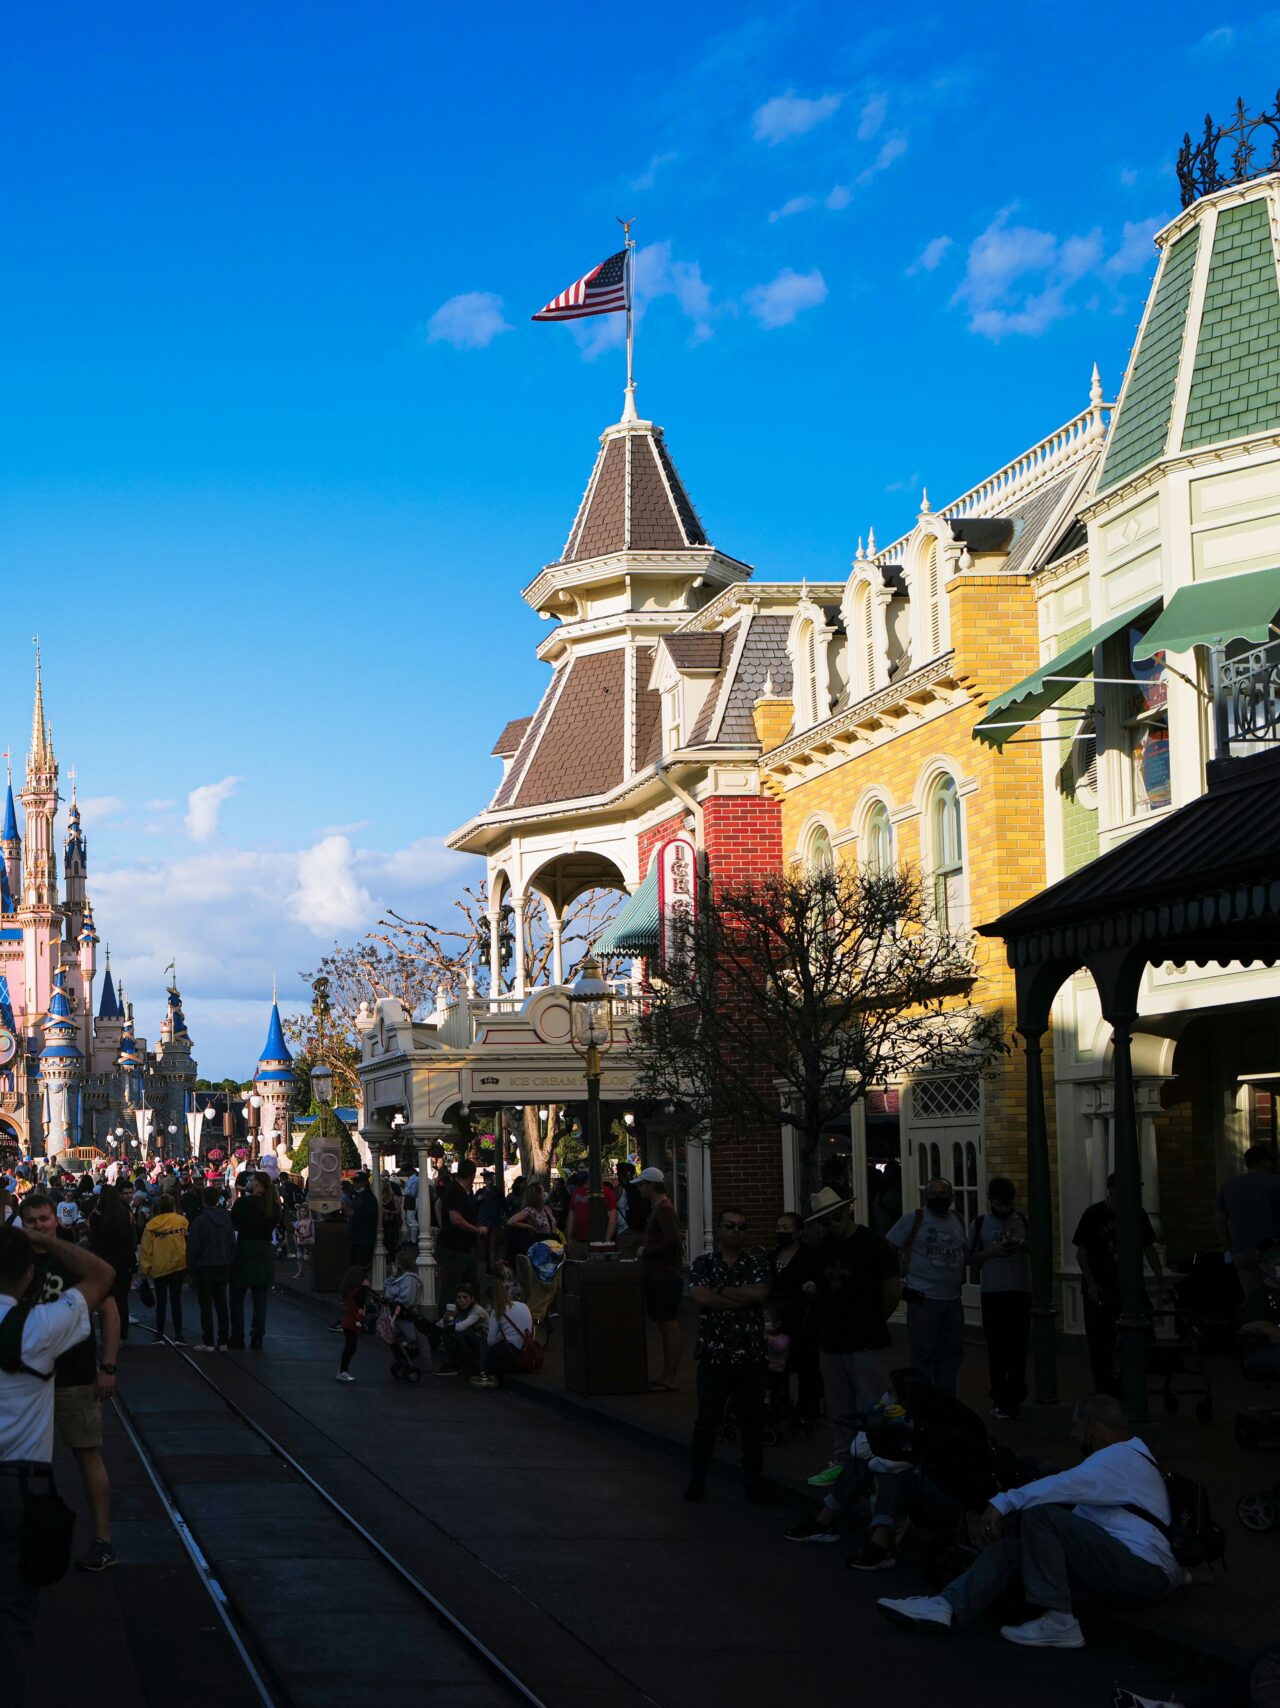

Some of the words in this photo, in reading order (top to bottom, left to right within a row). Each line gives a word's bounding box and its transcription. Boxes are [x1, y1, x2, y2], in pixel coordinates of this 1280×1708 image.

[671, 844, 689, 894] ICE
[509, 1076, 529, 1086] ICE
[532, 1076, 576, 1086] CREAM
[311, 1152, 339, 1181] 50
